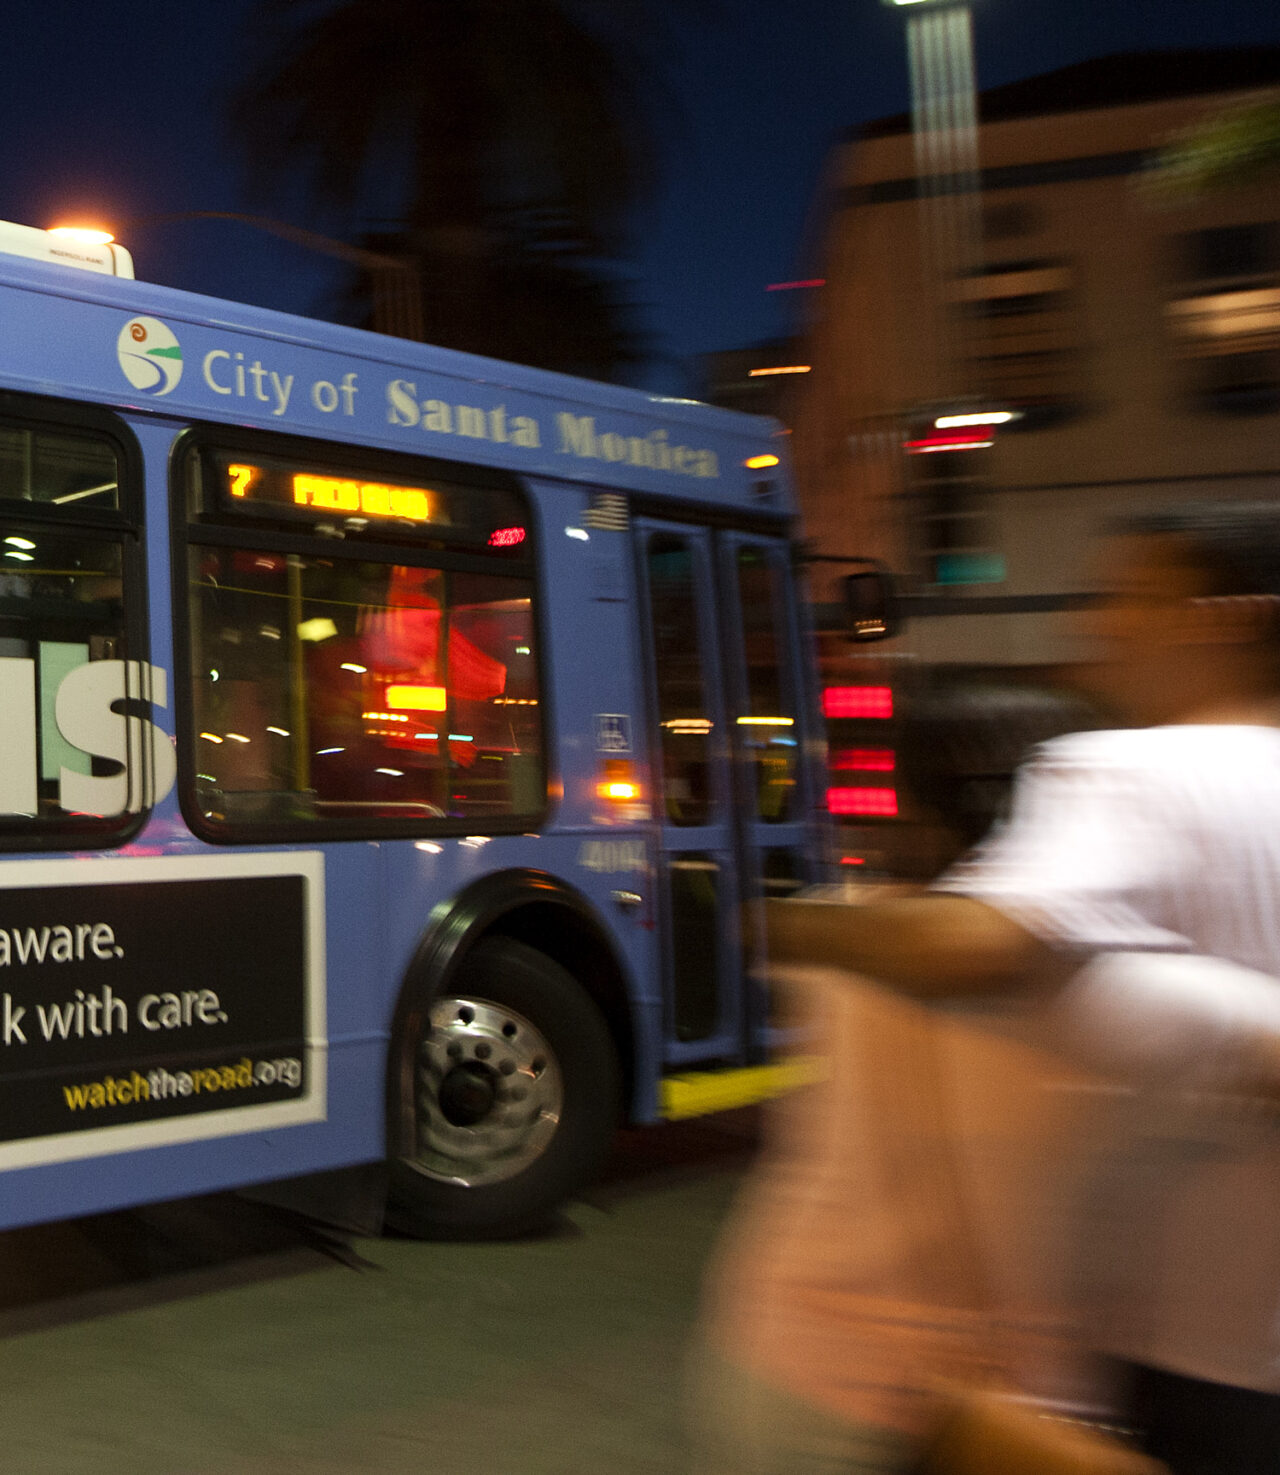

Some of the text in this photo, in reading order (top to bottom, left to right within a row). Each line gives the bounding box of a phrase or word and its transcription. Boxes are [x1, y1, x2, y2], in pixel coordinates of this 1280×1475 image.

[203, 349, 719, 478] City of Santa Monica
[227, 463, 254, 497] 7
[35, 985, 129, 1041] with
[137, 988, 228, 1031] care.
[62, 1057, 302, 1110] watchtheroad.org
